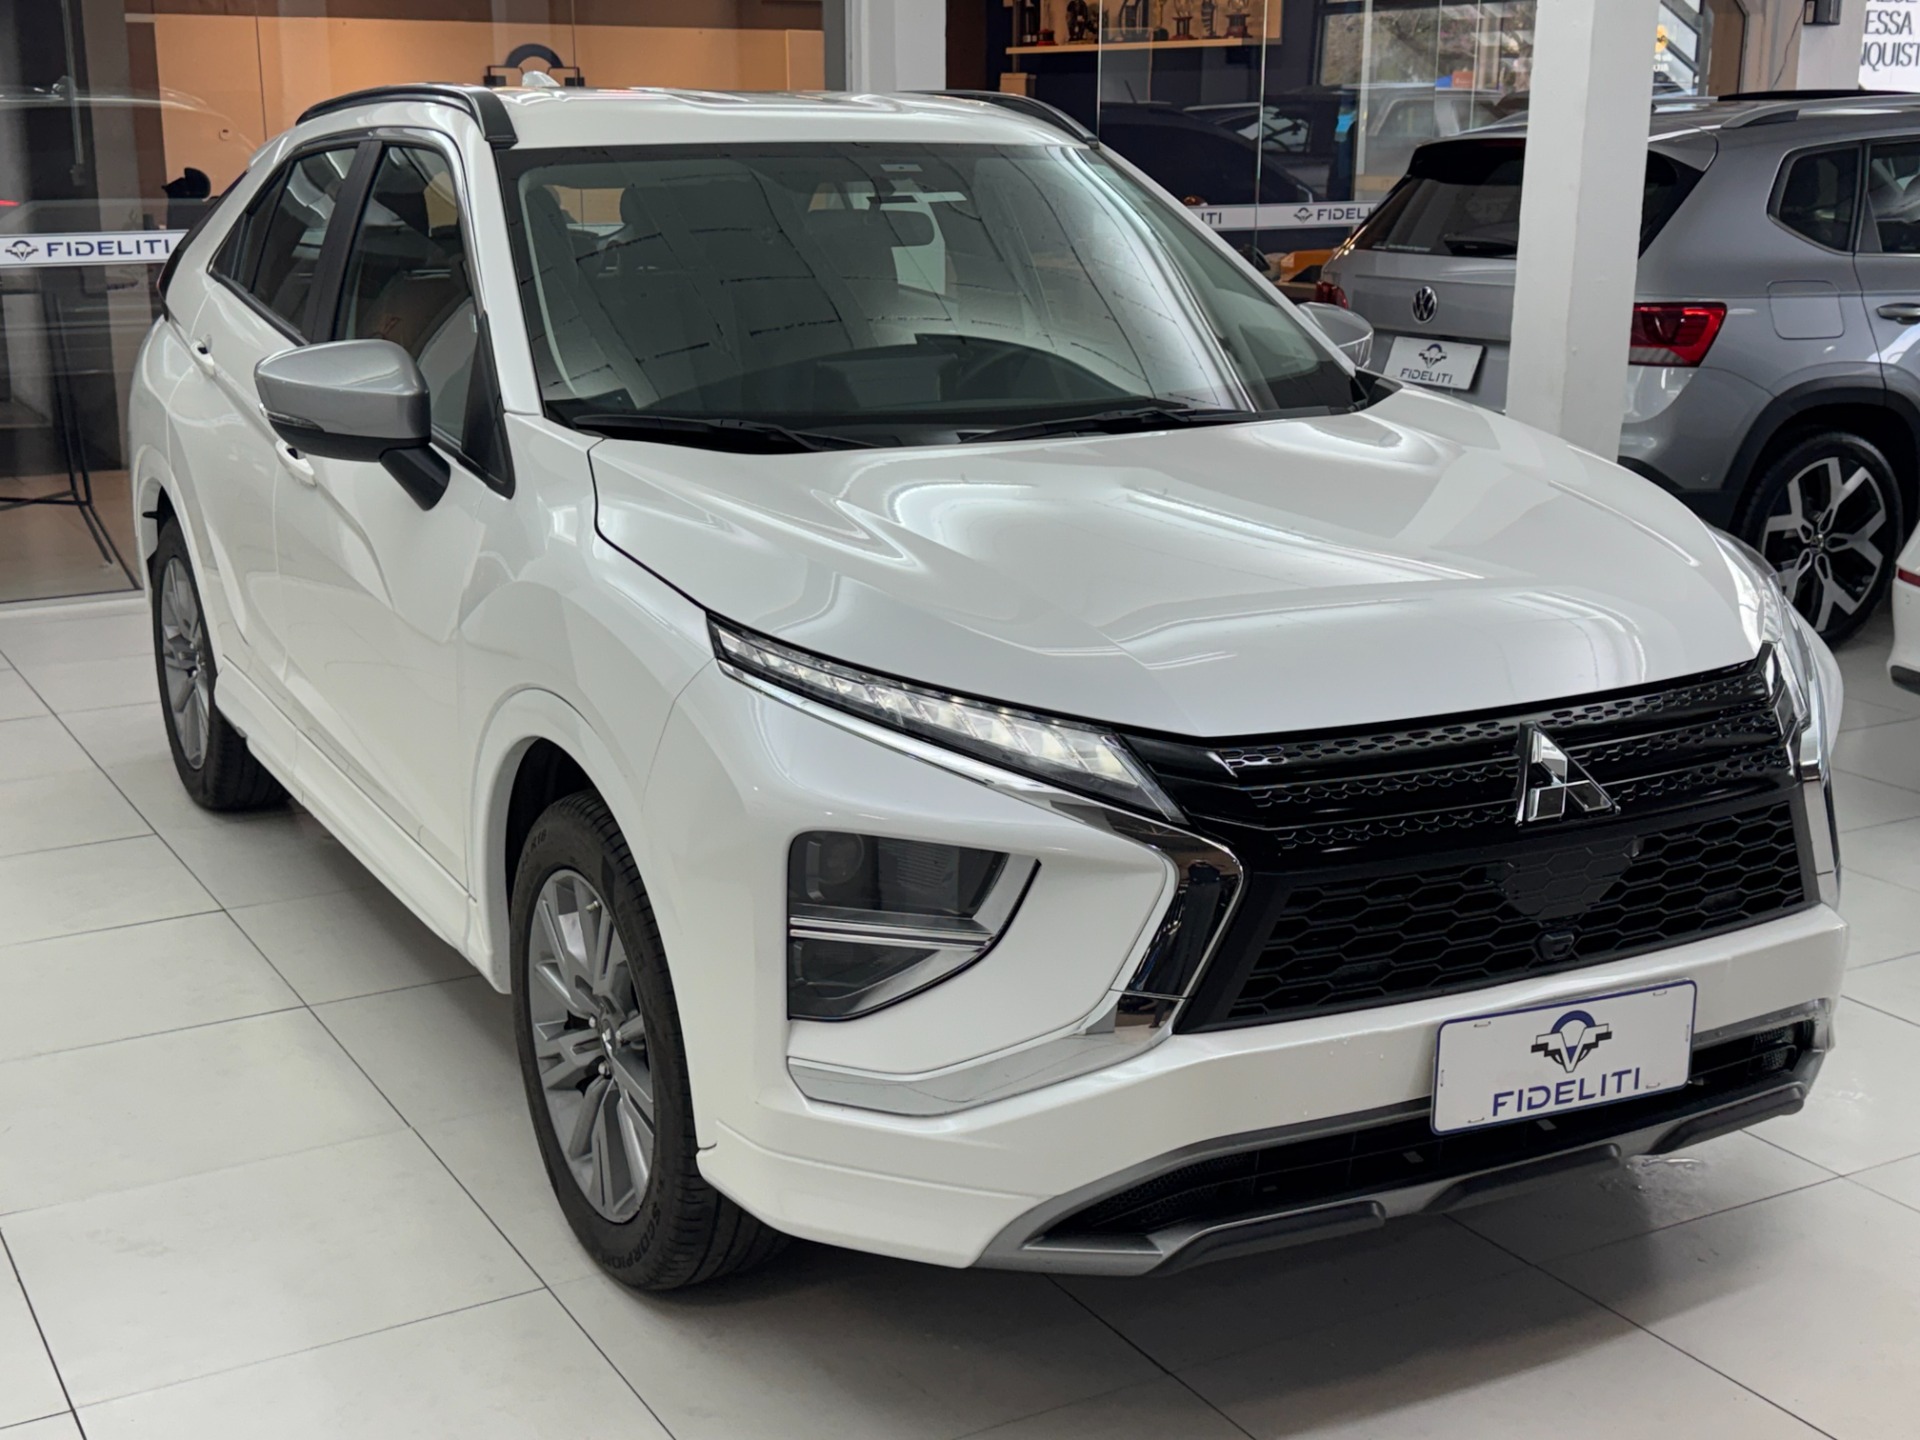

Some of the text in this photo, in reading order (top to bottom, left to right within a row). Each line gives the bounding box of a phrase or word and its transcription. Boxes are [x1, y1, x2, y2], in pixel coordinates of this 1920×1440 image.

[46, 239, 170, 257] FIDELITI
[1400, 368, 1453, 384] FIDELITI
[1492, 1067, 1641, 1117] FIDELITI
[601, 1201, 662, 1269] SCORPION
